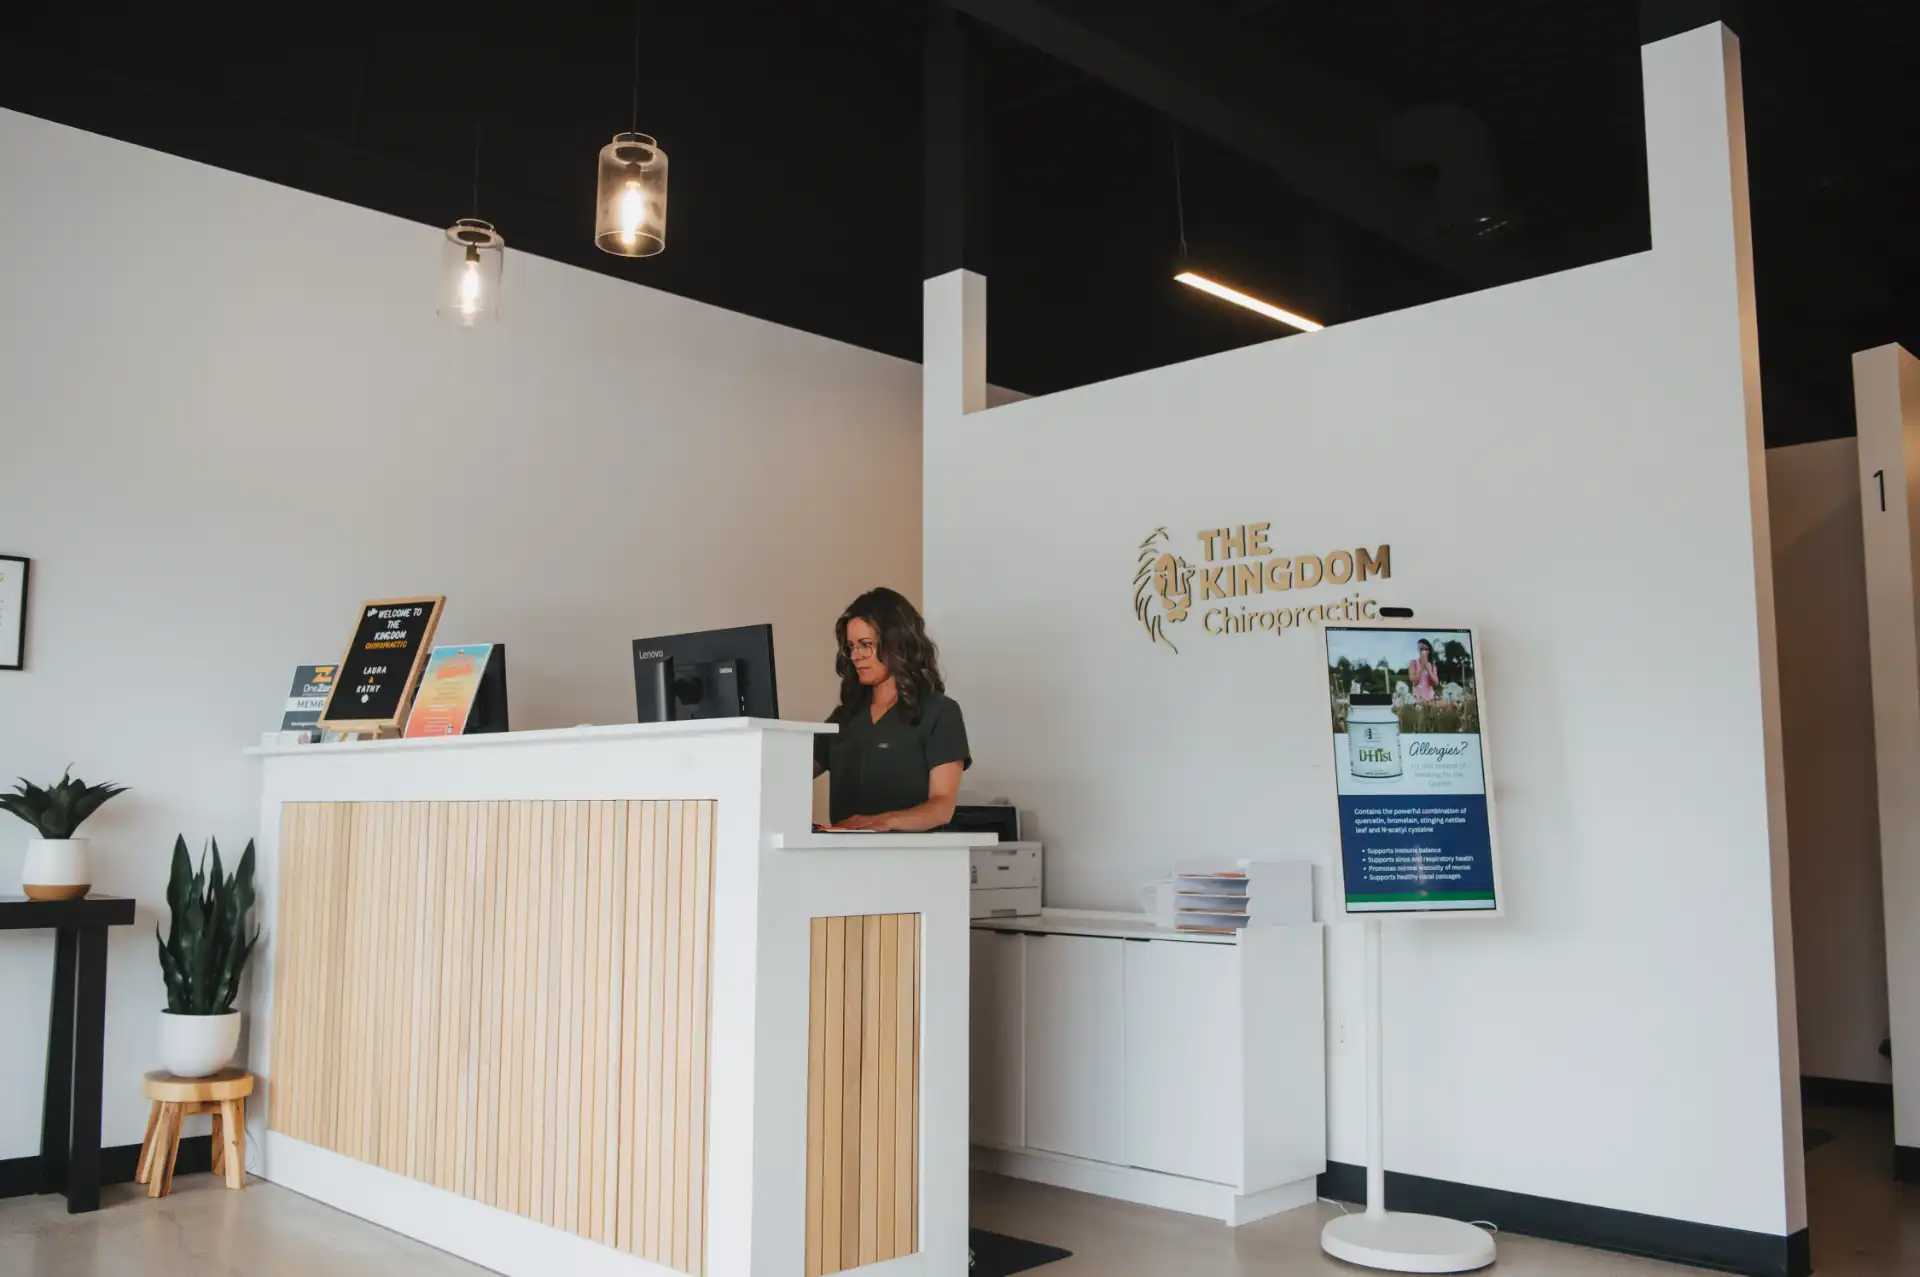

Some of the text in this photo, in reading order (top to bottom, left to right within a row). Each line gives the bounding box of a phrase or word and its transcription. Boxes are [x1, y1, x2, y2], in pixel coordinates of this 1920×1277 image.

[1873, 469, 1886, 512] 1
[1197, 522, 1273, 561] THE
[1199, 544, 1391, 600] KINGDOM
[378, 607, 422, 618] WELCOME TO
[1203, 593, 1378, 636] Chiropractic
[387, 620, 401, 628] THE
[374, 630, 407, 640] KINGDOM
[365, 640, 408, 649] CHIROPRACTIC
[639, 650, 663, 659] Lenovo
[363, 665, 387, 674] LAURA
[355, 684, 381, 693] KATHY
[297, 700, 323, 708] MEMB
[1409, 741, 1468, 762] Allergies?
[1420, 817, 1444, 825] stinging
[1408, 826, 1434, 835] cysteine
[1369, 874, 1396, 882] Supports
